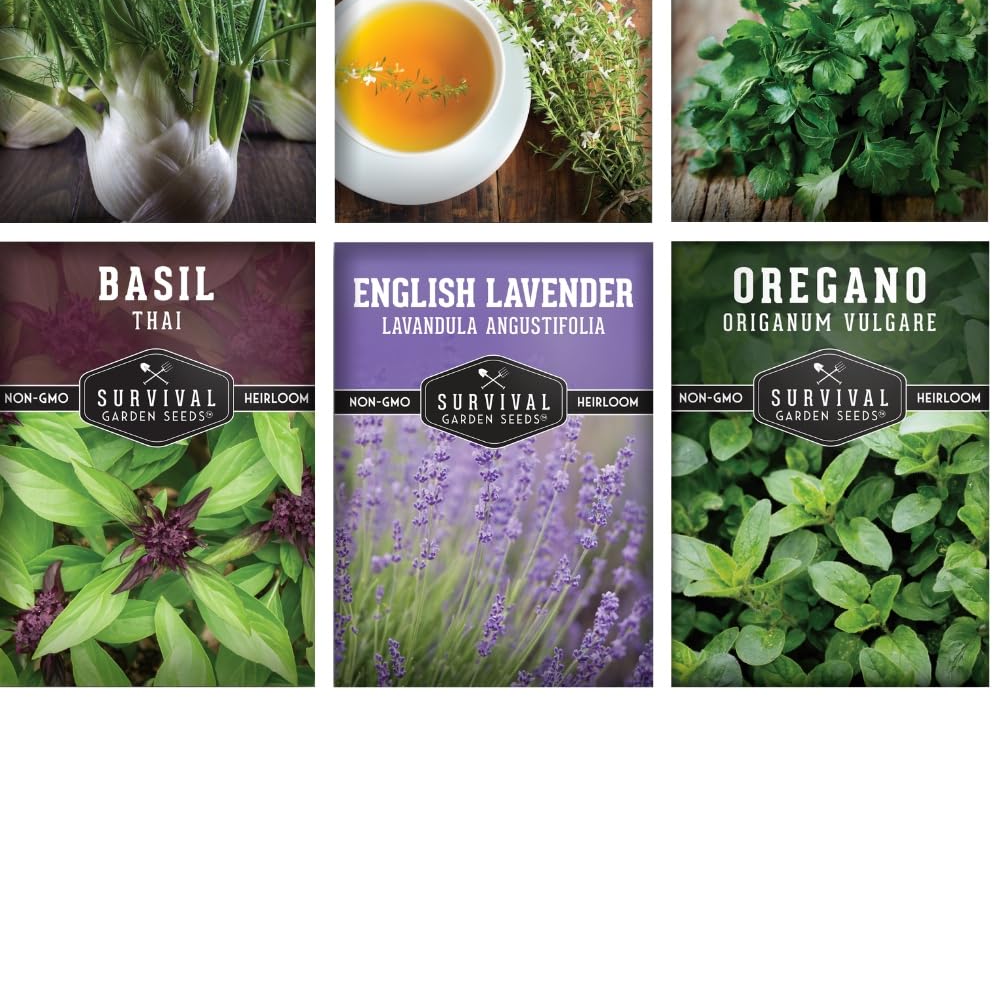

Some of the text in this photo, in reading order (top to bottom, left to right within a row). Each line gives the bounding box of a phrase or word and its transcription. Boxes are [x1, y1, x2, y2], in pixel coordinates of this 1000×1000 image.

[99, 266, 214, 301] BASIL
[734, 267, 925, 303] OREGANO
[354, 278, 633, 307] ENGLISH LAVENDER
[132, 311, 180, 329] THAI
[383, 317, 604, 334] LAVANDULA ANGUSTIFOLIA
[724, 313, 936, 331] ORIGANUM VULGARE
[5, 393, 68, 403] NON-GMO
[98, 389, 215, 406] SURVIVAL
[245, 393, 308, 403] HEIRLOOM
[350, 397, 410, 407] NON-GMO
[438, 394, 550, 410] SURVIVAL
[578, 397, 638, 407] HEIRLOOM
[680, 393, 742, 403] NON-GMO
[772, 389, 888, 406] SURVIVAL
[918, 393, 980, 403] HEIRLOOM
[102, 411, 155, 421] GARDEN
[442, 414, 492, 424] GARDEN
[776, 411, 828, 420] GARDEN
